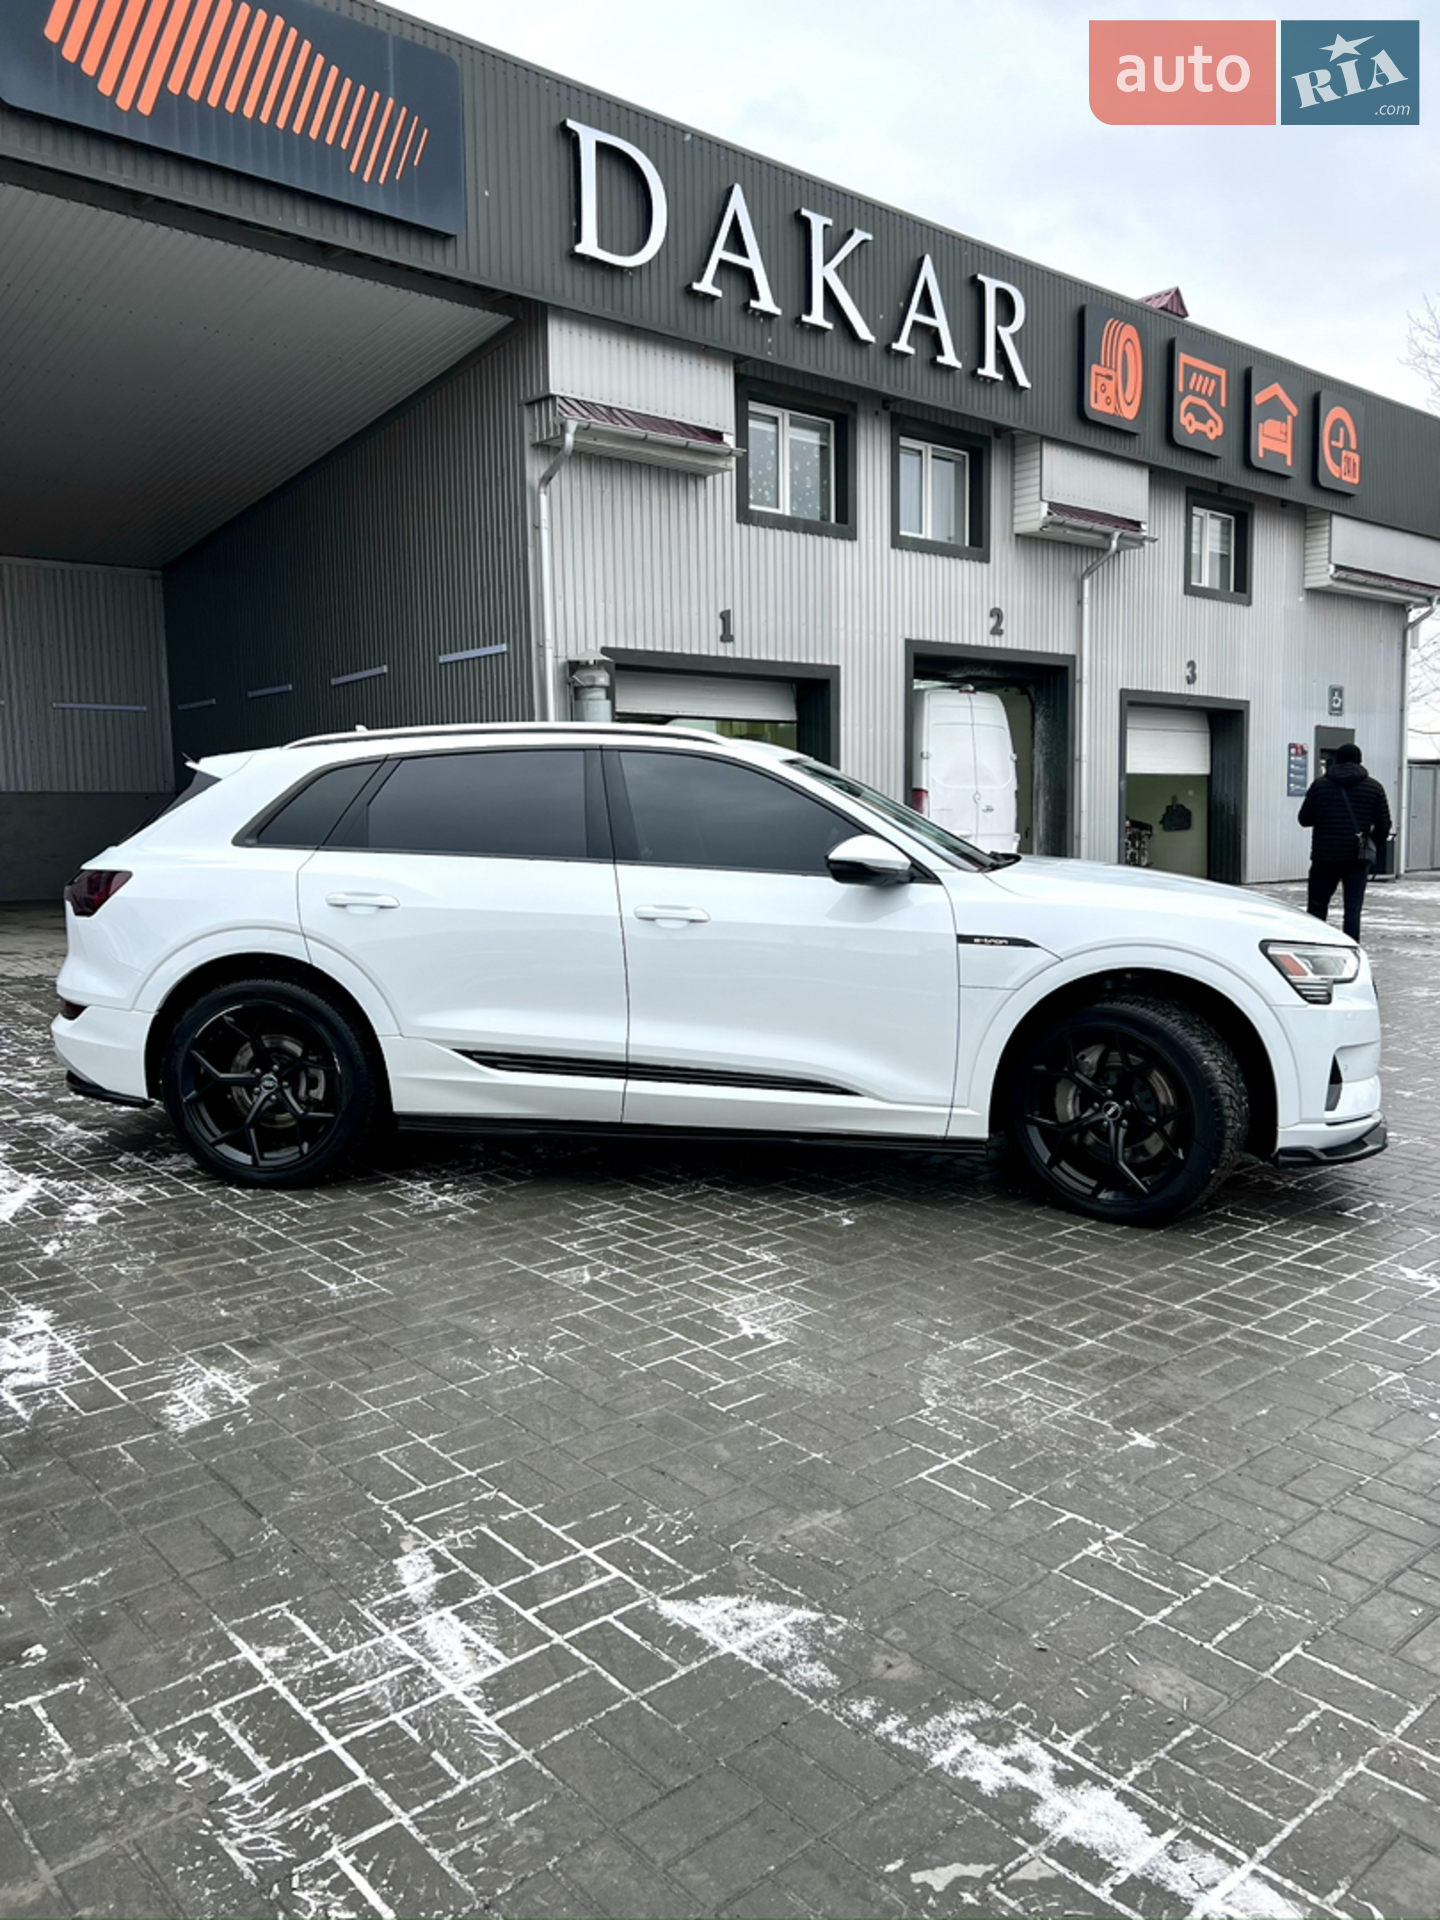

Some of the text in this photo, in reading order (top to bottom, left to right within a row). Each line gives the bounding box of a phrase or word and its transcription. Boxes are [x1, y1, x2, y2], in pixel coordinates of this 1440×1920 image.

[562, 117, 1032, 390] DAKAR
[719, 608, 735, 643] 1
[989, 607, 1004, 636] 2
[1185, 660, 1198, 685] 3
